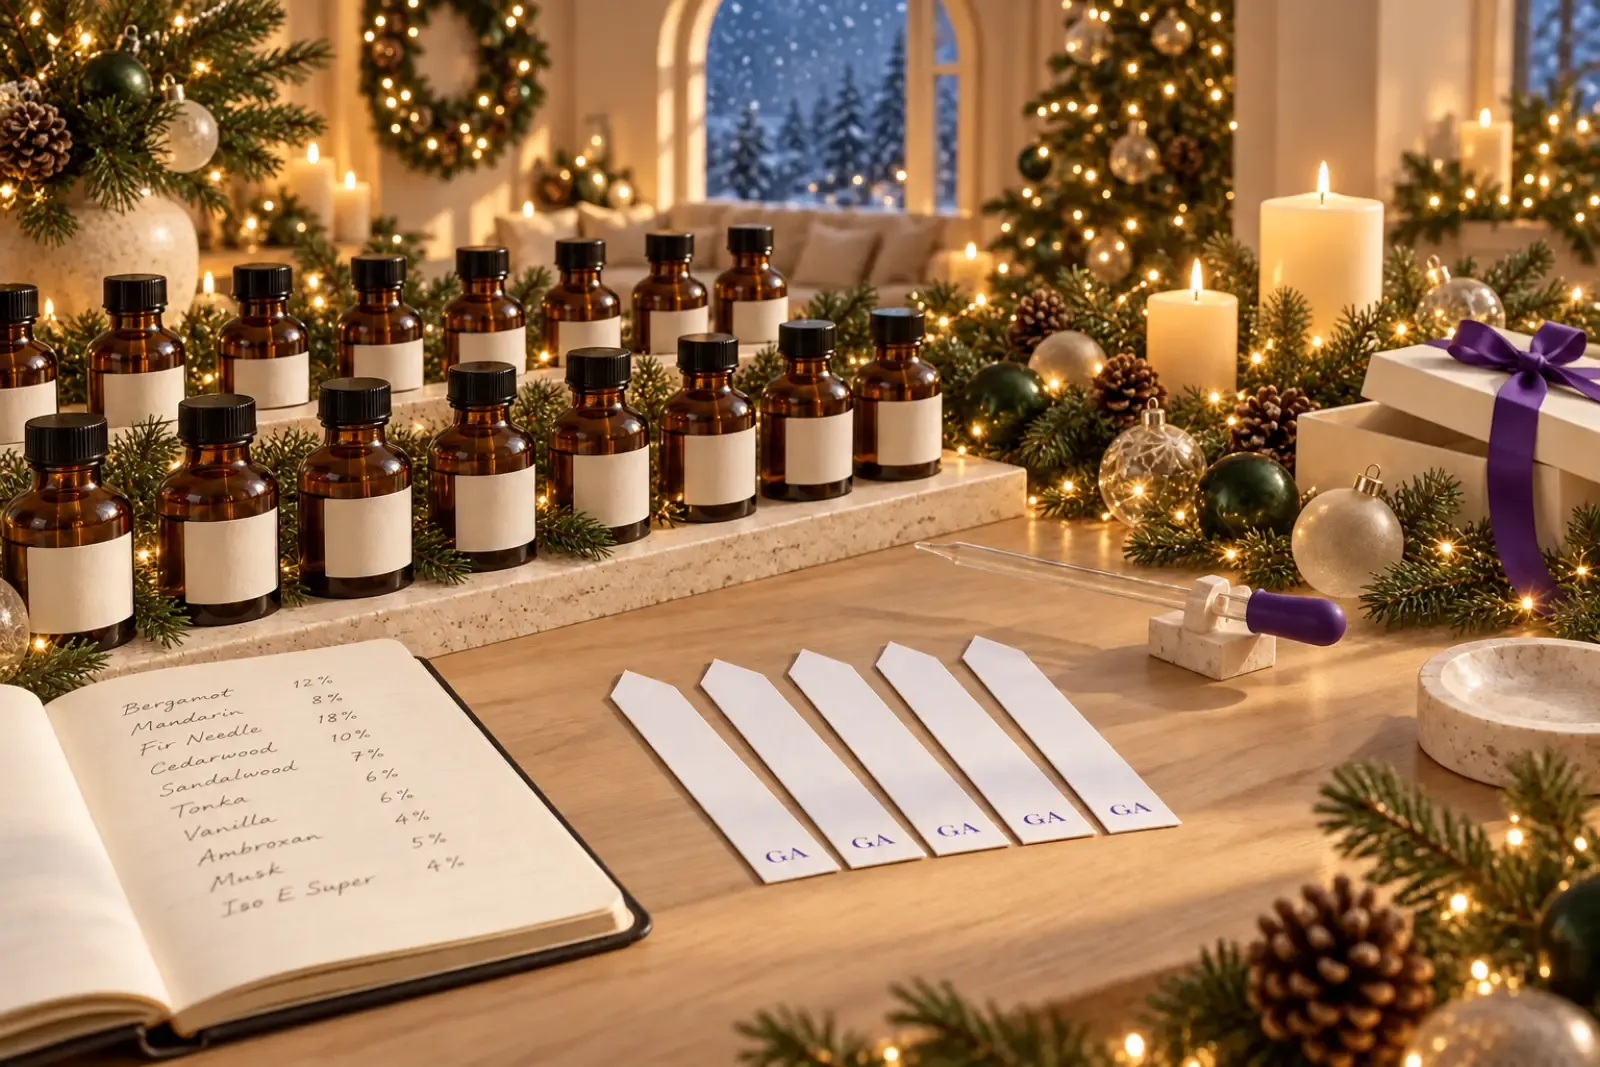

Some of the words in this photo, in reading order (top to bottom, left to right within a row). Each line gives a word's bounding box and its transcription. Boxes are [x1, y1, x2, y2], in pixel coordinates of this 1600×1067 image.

[122, 688, 234, 716] Bergamot
[131, 708, 244, 736] Mandarin
[141, 741, 176, 756] Fir
[187, 724, 262, 746] Needle
[150, 742, 278, 776] Cedarwood
[159, 760, 299, 798] Sandalwood
[171, 794, 248, 818] Tonka
[1024, 812, 1066, 824] GA
[1110, 803, 1151, 815] GA
[184, 815, 277, 841] Vanilla
[852, 835, 894, 848] GA
[937, 823, 979, 836] GA
[198, 833, 323, 866] Ambroxan
[766, 848, 808, 862] GA
[210, 862, 285, 892] Musk
[278, 888, 296, 903] E
[306, 874, 378, 897] Super
